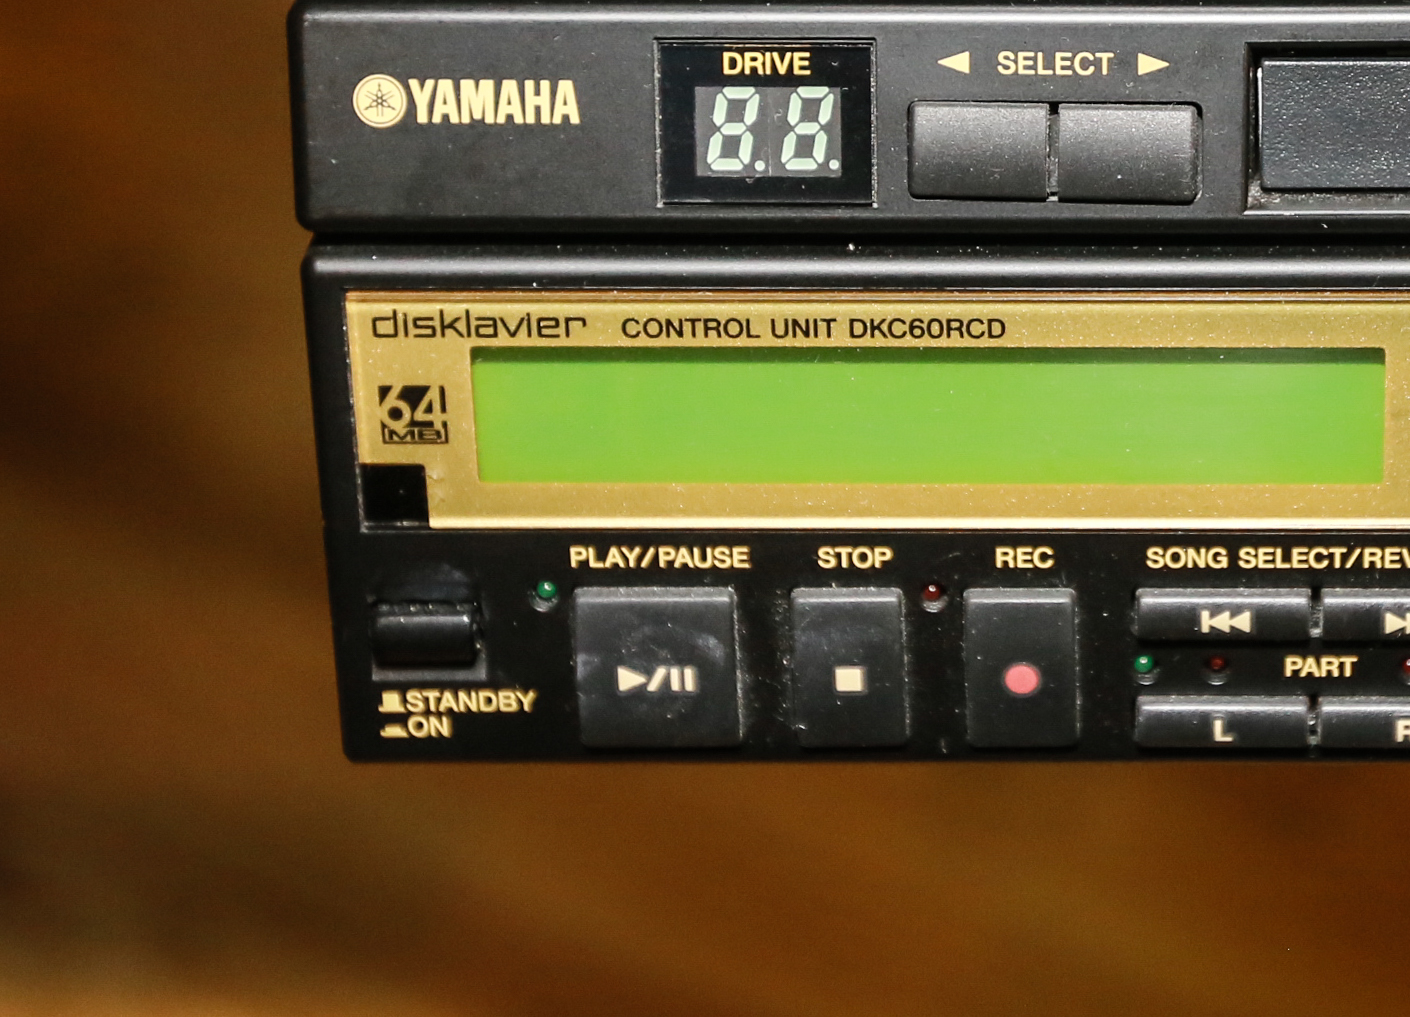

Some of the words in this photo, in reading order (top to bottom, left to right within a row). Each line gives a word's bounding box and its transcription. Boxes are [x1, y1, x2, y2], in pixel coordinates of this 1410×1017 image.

[722, 51, 811, 75] DRIVE
[997, 51, 1115, 76] SELECT
[408, 79, 580, 124] YAMAHA
[372, 310, 587, 339] disklavier
[621, 318, 761, 339] CONTROL
[771, 317, 837, 338] UNIT
[849, 318, 1006, 339] DKC60RCD
[379, 385, 448, 430] 64
[384, 426, 446, 443] MB
[569, 546, 751, 570] PLAY/PAUSE
[817, 546, 893, 570] STOP
[995, 546, 1055, 570] REC
[1145, 546, 1229, 570] SONG
[1284, 657, 1358, 678] PART
[405, 689, 537, 714] STANDBY
[405, 715, 453, 738] ON
[1213, 720, 1234, 743] L
